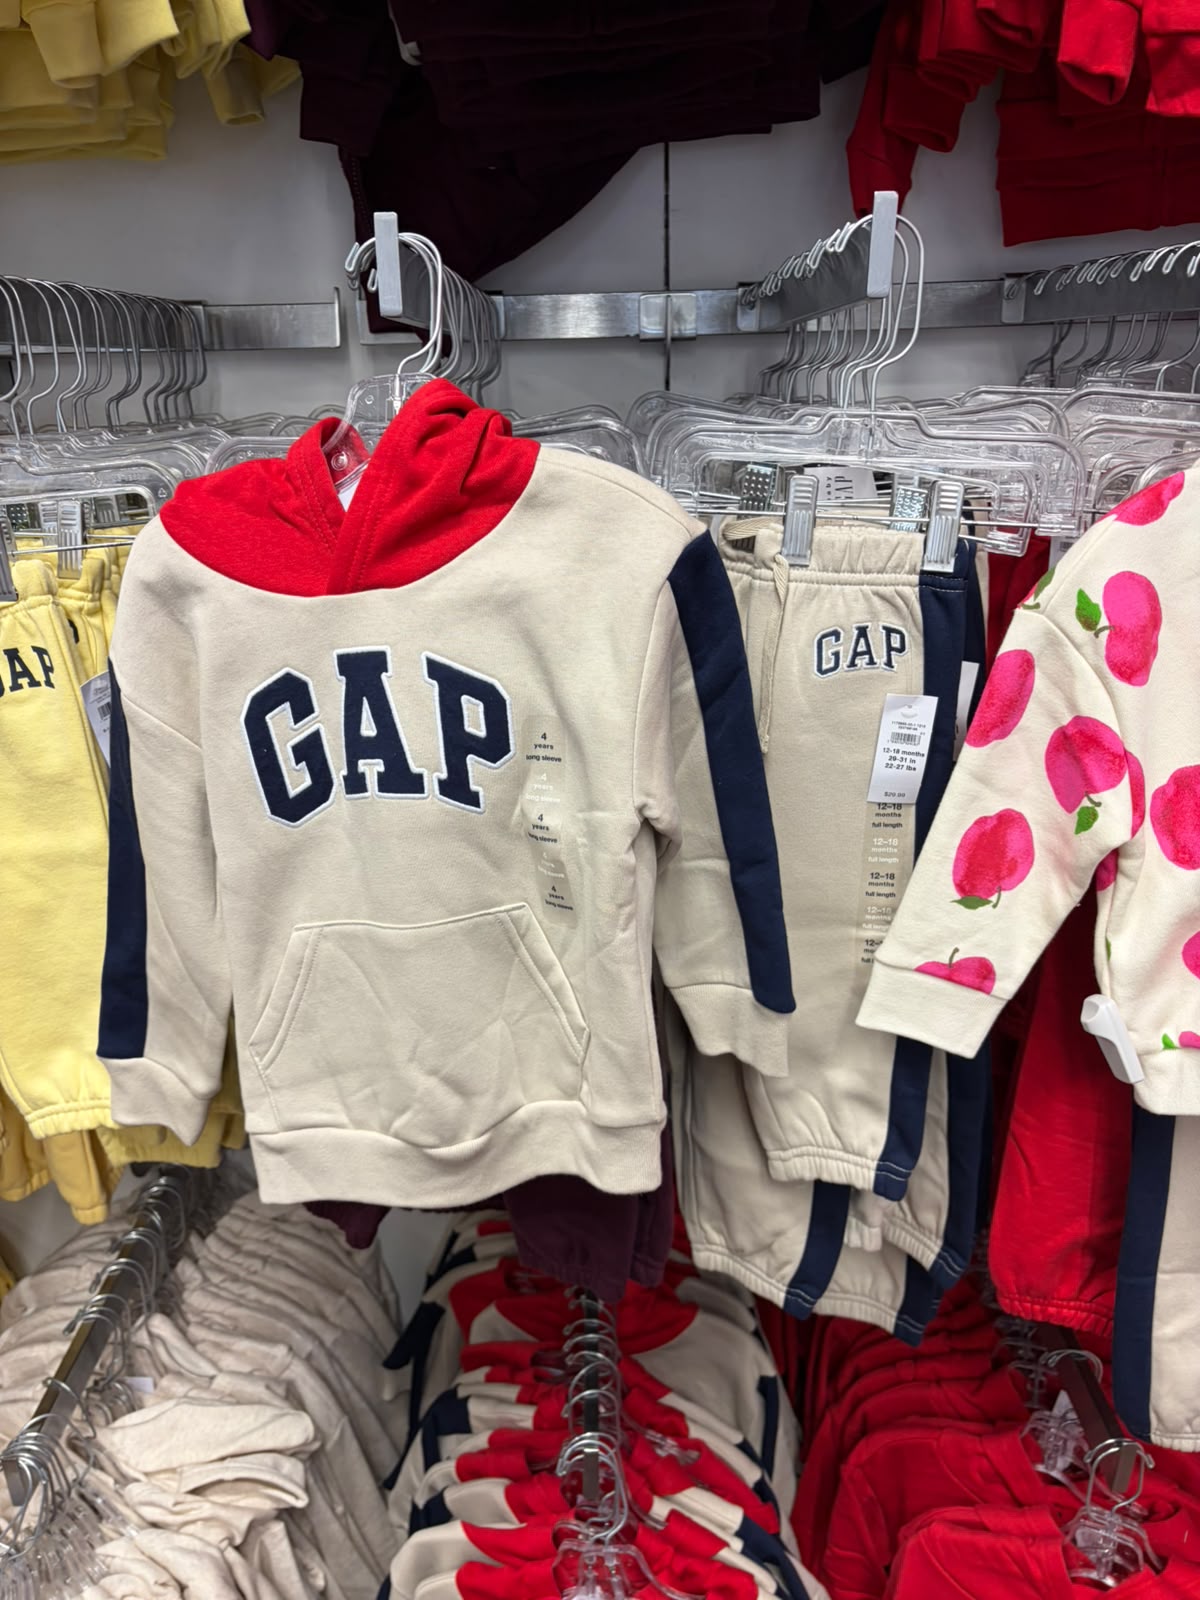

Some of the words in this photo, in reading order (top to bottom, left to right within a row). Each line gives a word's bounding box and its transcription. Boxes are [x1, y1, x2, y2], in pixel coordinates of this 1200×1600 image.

[815, 622, 908, 678] GAP
[0, 645, 55, 698] AP
[240, 645, 515, 827] GAP
[541, 732, 547, 741] 4
[883, 747, 900, 755] 12-18
[902, 748, 925, 758] months
[540, 772, 547, 781] 4
[870, 872, 895, 880] 12-18
